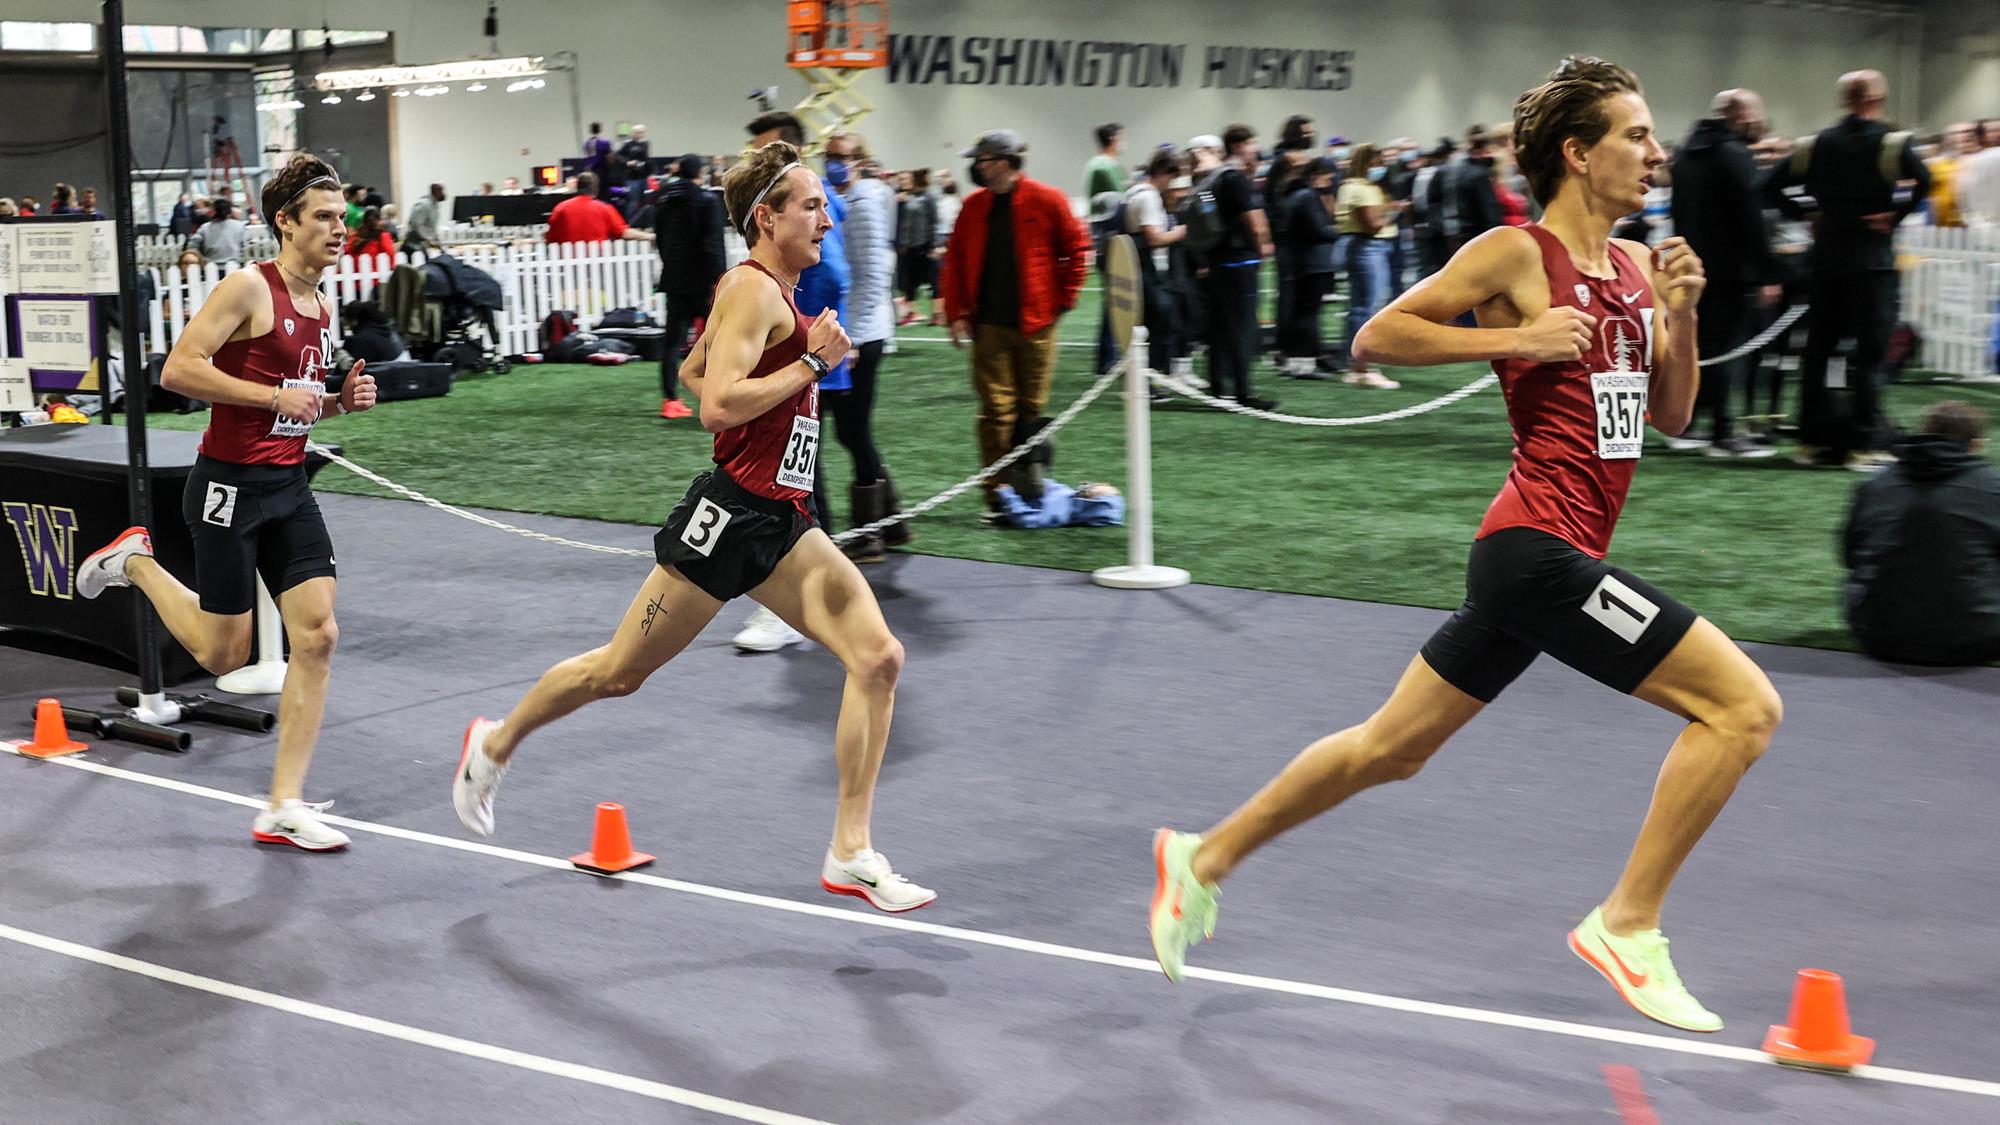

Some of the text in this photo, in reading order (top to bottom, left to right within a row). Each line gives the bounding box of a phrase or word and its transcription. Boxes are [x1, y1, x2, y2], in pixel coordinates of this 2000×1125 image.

[886, 34, 1355, 91] WASHINGTON HUSKIES
[1598, 392, 1646, 439] 357
[207, 486, 229, 524] 2
[687, 505, 721, 548] 3
[2, 501, 79, 600] W
[1599, 588, 1647, 624] 1
